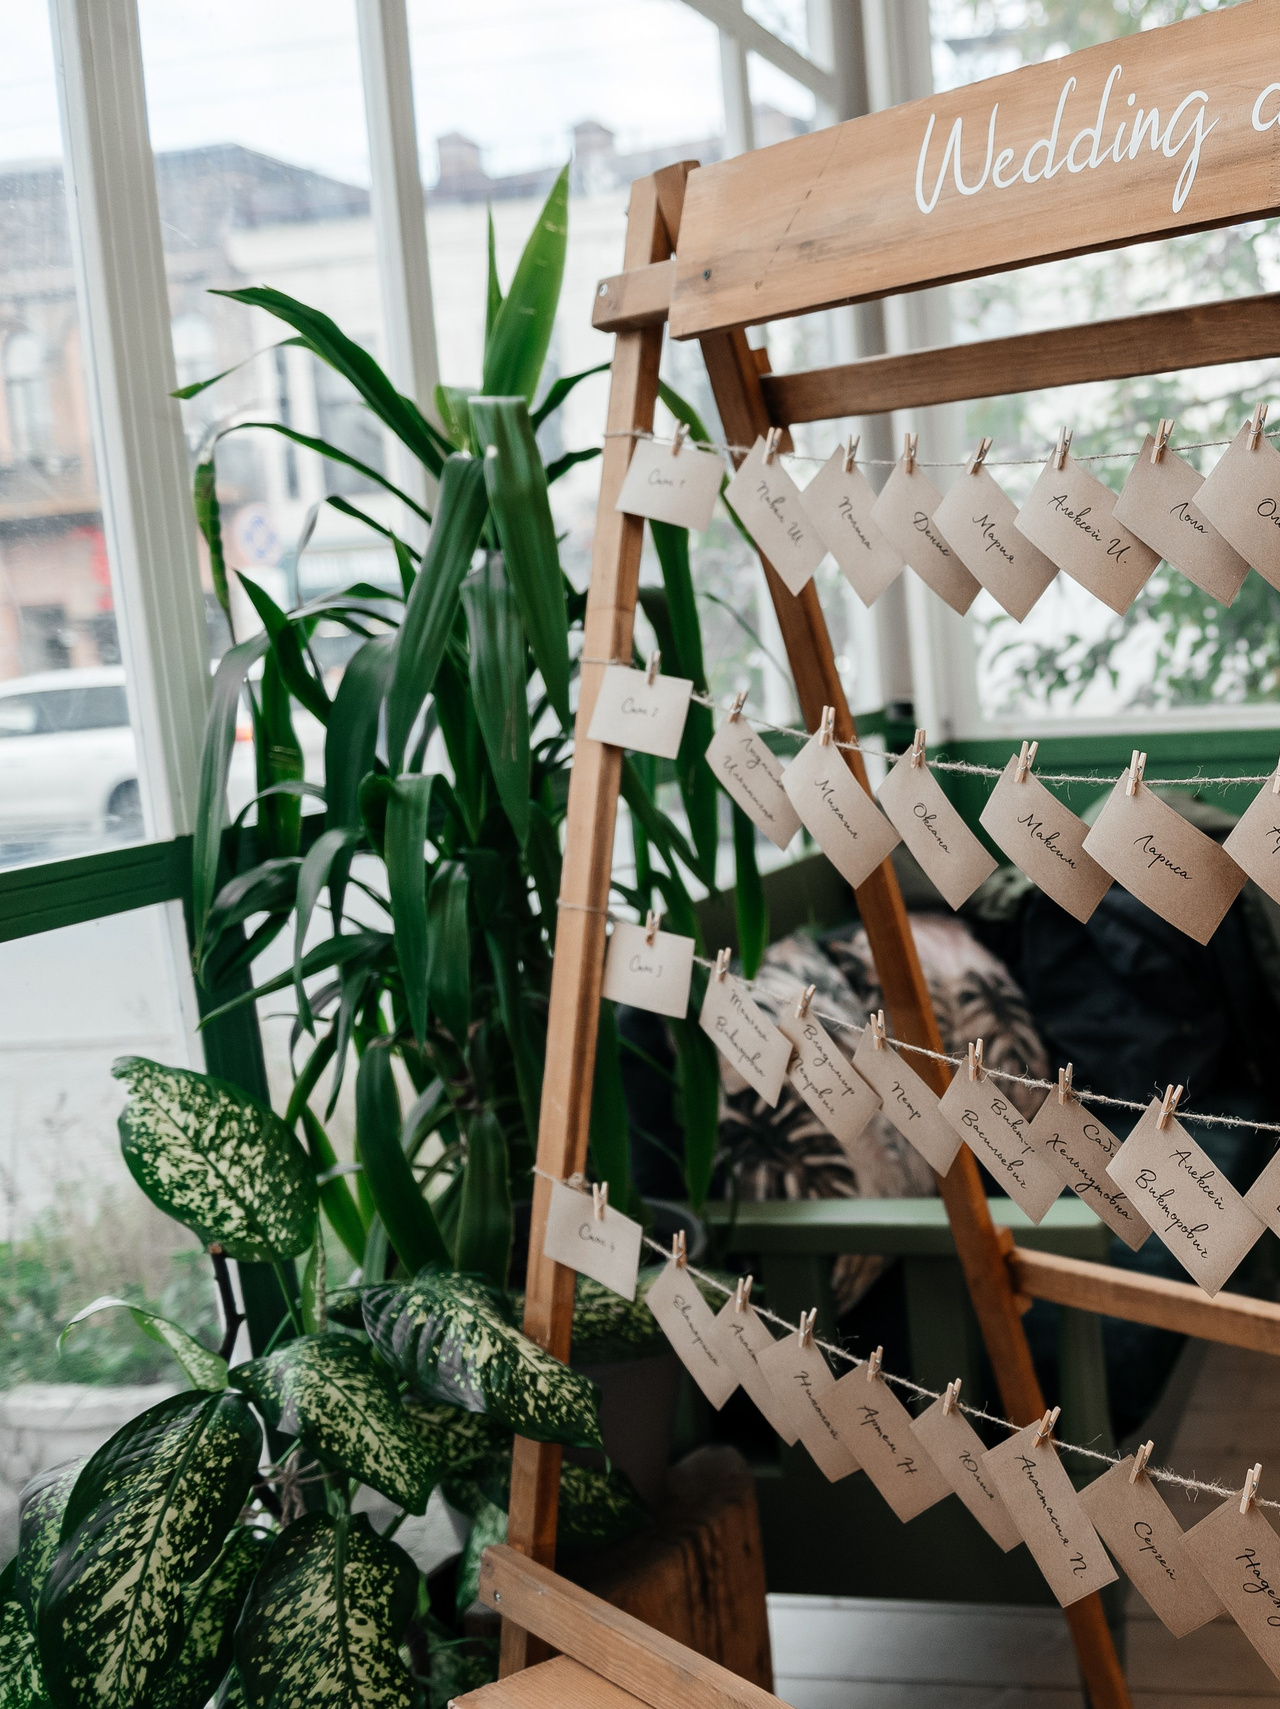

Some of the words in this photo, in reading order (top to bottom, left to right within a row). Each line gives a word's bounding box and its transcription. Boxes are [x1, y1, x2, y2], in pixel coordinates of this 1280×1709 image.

[915, 64, 1220, 214] Wedding
[913, 511, 950, 557] Денис
[972, 514, 1014, 565] Мария
[1047, 494, 1102, 542] Алексей
[814, 779, 858, 840] Михаил
[913, 802, 951, 854] Оксана
[1017, 813, 1077, 870] Максим
[1133, 834, 1194, 881] Лариса
[803, 1024, 855, 1097] Владимир
[891, 1081, 922, 1120] Петр
[961, 1109, 1027, 1190] Васильевич
[1045, 1133, 1133, 1221] Хельмутовна
[1169, 1148, 1226, 1211] Алексей
[1135, 1168, 1208, 1260] Викторович
[857, 1404, 897, 1454] Артем
[959, 1451, 995, 1501] Юлия
[1014, 1454, 1070, 1548] Анастасия
[1133, 1521, 1176, 1581] Сергей
